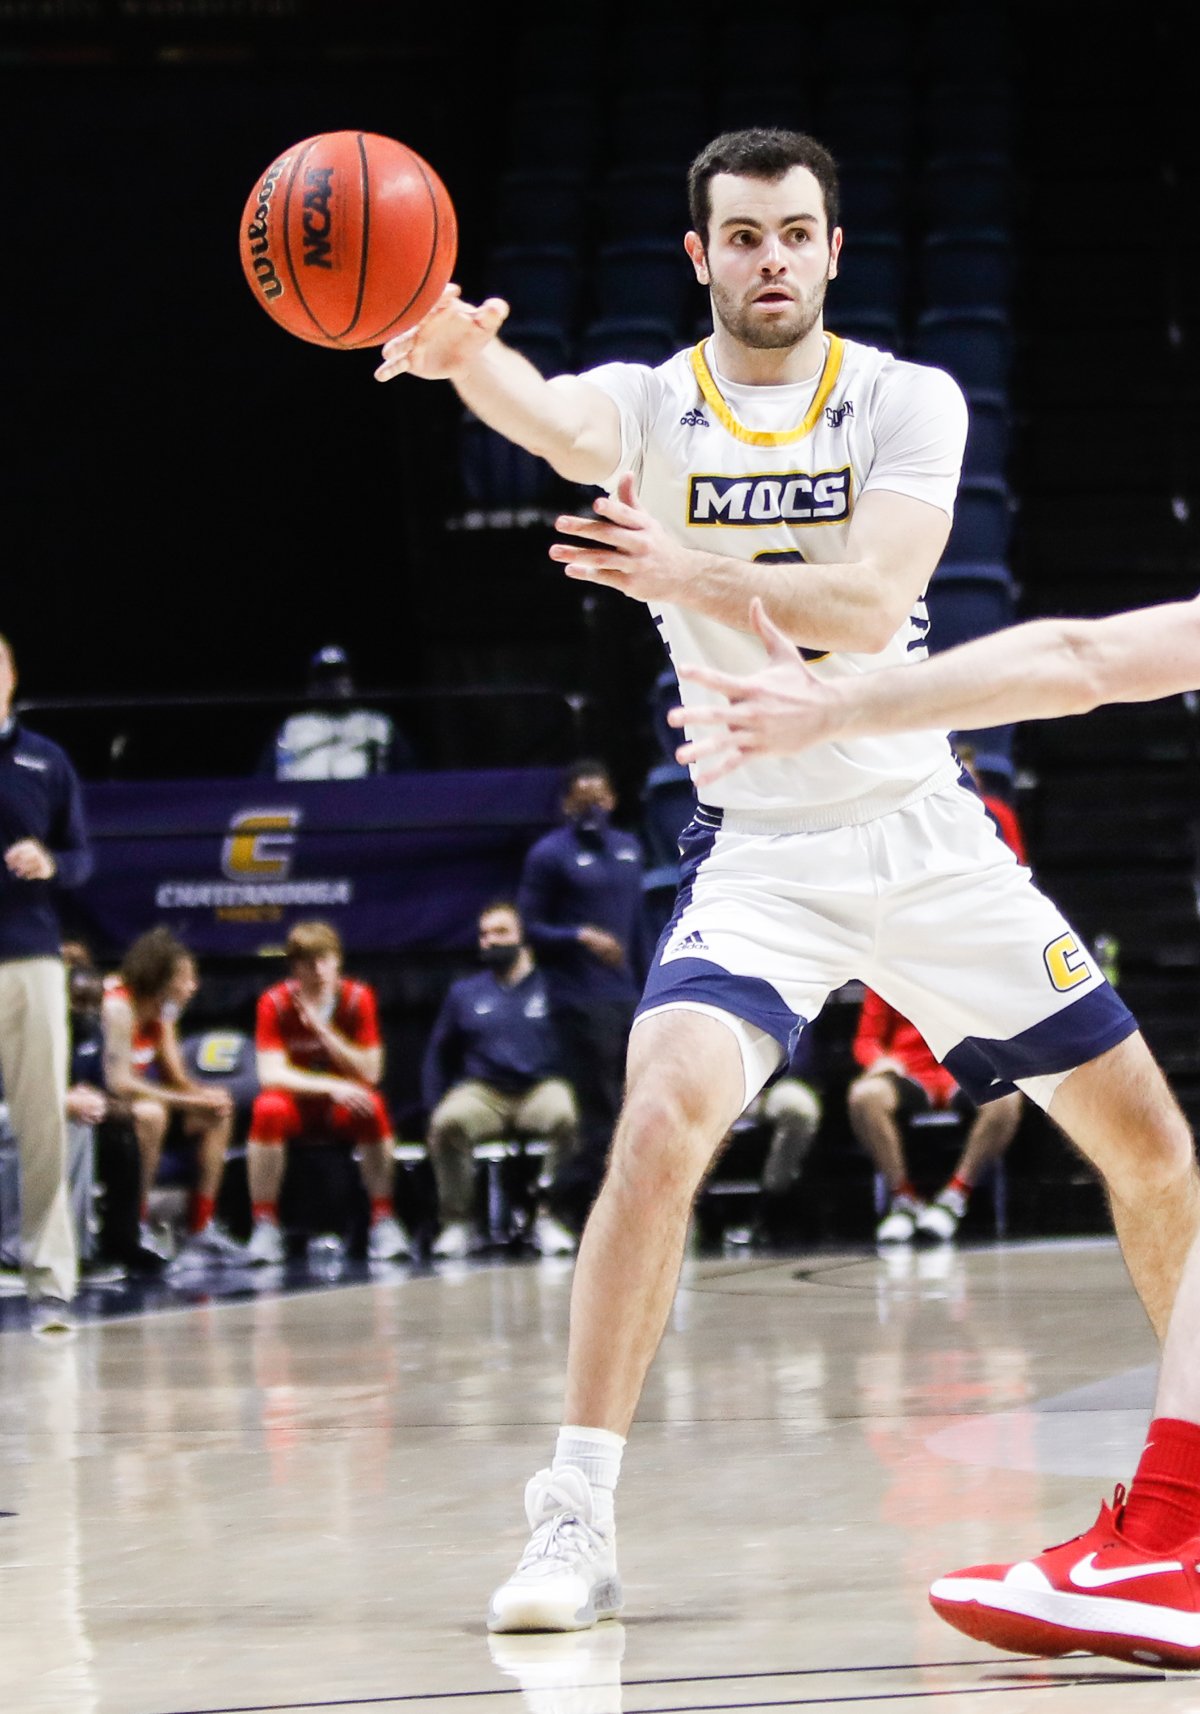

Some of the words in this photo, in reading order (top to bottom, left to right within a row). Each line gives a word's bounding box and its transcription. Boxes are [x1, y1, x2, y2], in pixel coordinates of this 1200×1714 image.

[248, 158, 288, 303] Wilson
[304, 168, 333, 269] NCAA
[693, 477, 847, 519] MOCS
[1043, 931, 1092, 992] C
